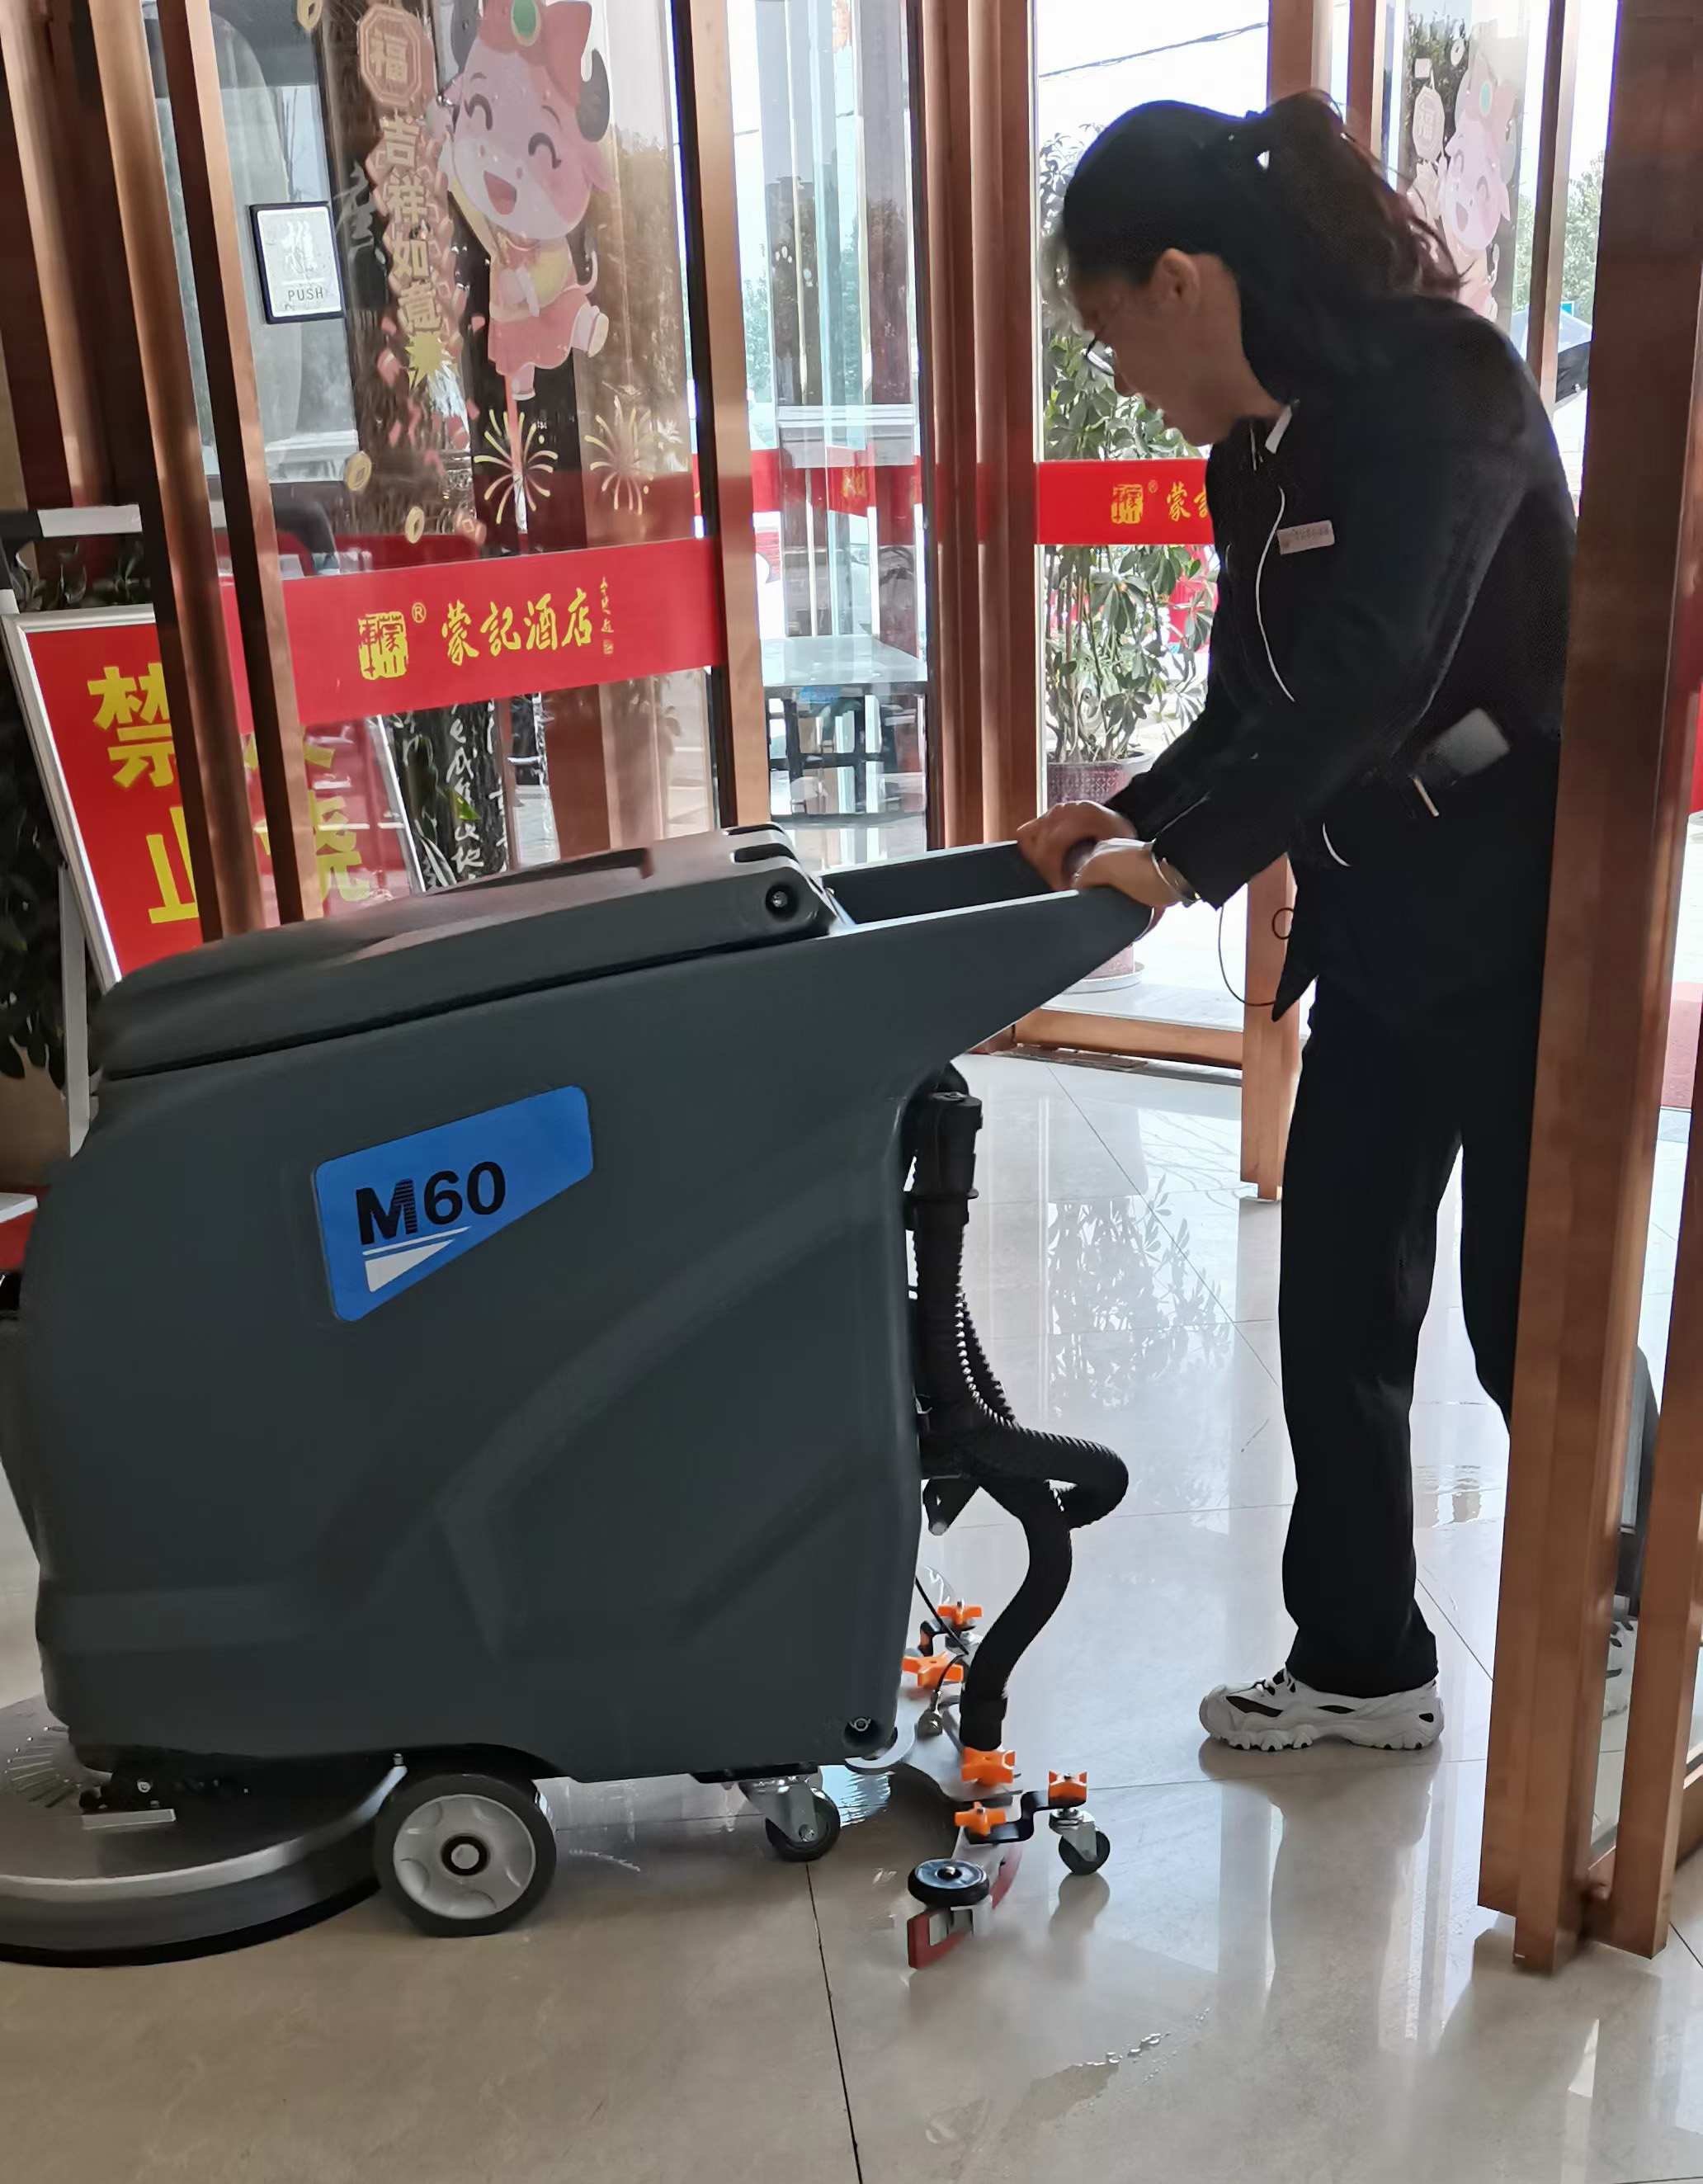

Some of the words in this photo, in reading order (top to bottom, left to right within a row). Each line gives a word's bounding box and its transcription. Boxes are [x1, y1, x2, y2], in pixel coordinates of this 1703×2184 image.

[380, 108, 443, 332] 吉祥如意
[287, 286, 323, 301] PUSH
[356, 1161, 506, 1246] M60
